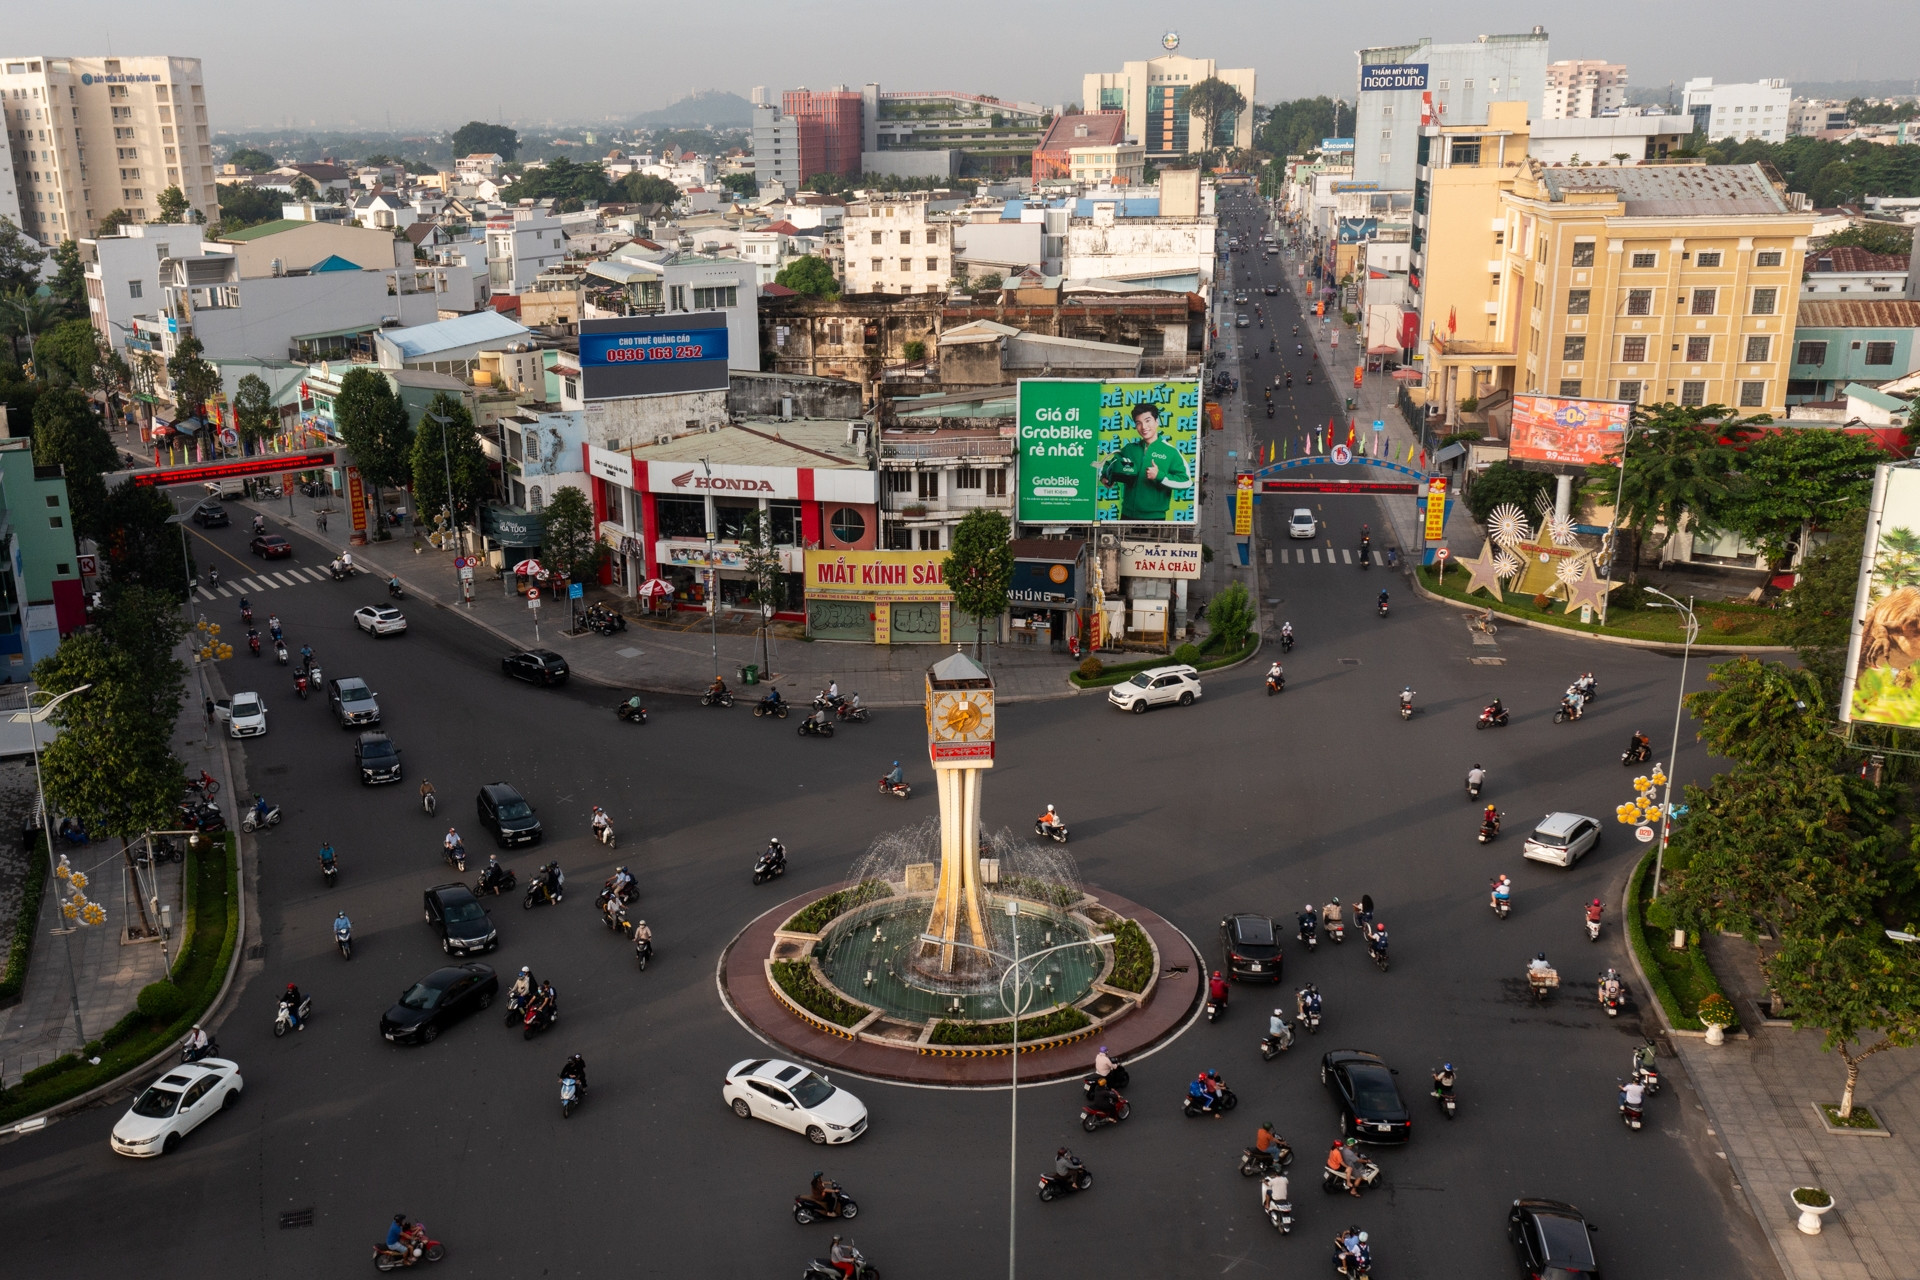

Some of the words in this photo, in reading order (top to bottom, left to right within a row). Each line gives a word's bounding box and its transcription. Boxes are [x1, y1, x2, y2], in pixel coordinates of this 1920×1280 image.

[1403, 67, 1419, 75] VIỆN
[1364, 77, 1393, 88] NGỌC
[1395, 76, 1424, 86] DUNG
[619, 337, 633, 346] CHO
[634, 335, 652, 345] THUÊ
[653, 334, 675, 344] QUẢNG
[677, 334, 690, 343] CÁO
[606, 348, 645, 362] 0936
[649, 346, 673, 360] 163
[676, 345, 702, 359] 252
[1101, 386, 1123, 408] RẺ
[1125, 383, 1175, 406] NHẤT
[1035, 407, 1062, 421] Giá
[1065, 408, 1080, 421] đi
[1100, 410, 1122, 431] RẺ
[1177, 411, 1198, 431] RẺ
[1022, 425, 1092, 439] GrabBike
[1029, 442, 1045, 456] rẻ
[1048, 442, 1084, 456] nhất
[1176, 435, 1197, 454] RẺ
[1151, 452, 1166, 460] Grab
[695, 477, 775, 492] HONDA
[1032, 476, 1079, 486] GrabBike
[1170, 548, 1197, 557] KÍNH
[817, 556, 857, 584] MẮT
[862, 561, 906, 585] KÍNH
[1135, 559, 1156, 570] TÂN
[1158, 560, 1165, 570] Á
[1168, 561, 1196, 572] CHÂU
